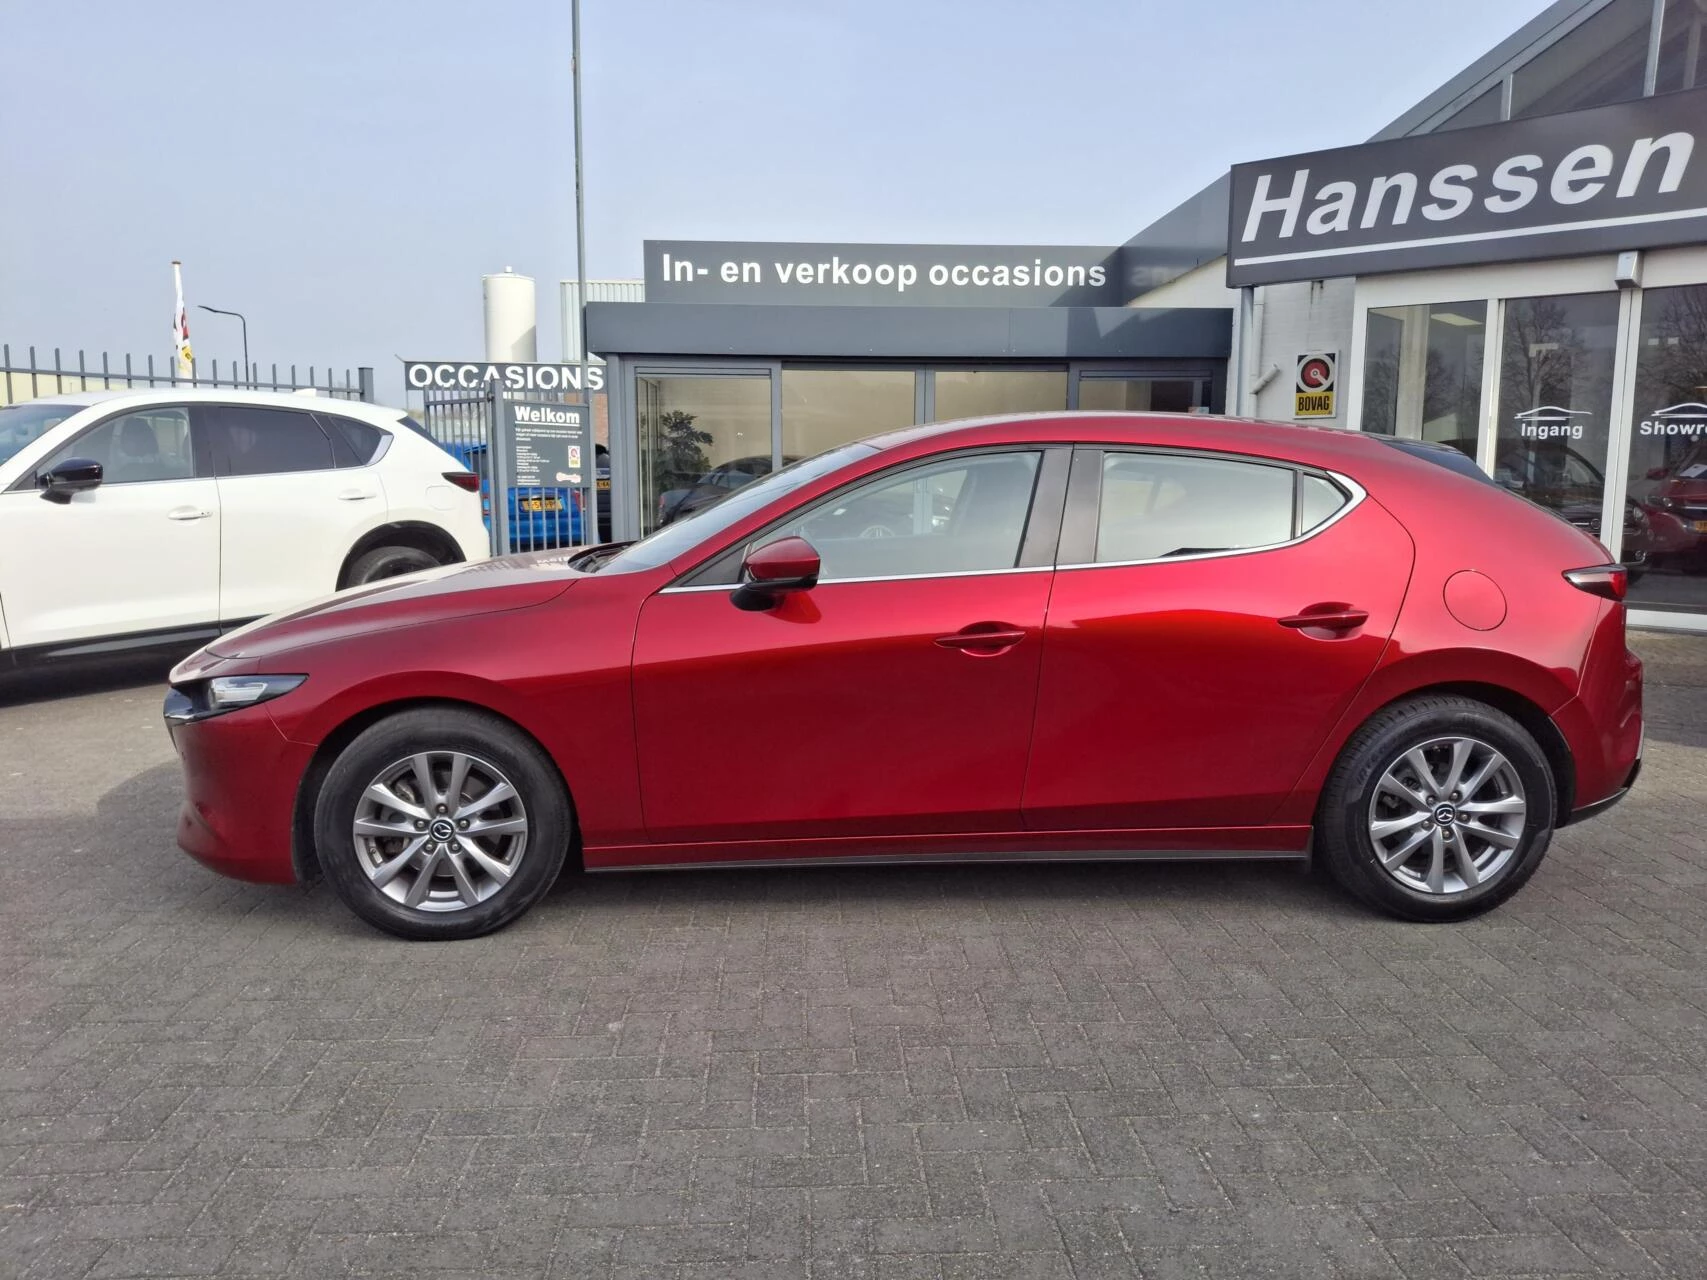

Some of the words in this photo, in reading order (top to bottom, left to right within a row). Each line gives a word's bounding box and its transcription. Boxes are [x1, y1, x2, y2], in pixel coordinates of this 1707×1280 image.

[1241, 132, 1695, 243] Hanssen
[662, 254, 709, 282] In-
[720, 260, 761, 283] en
[774, 256, 918, 292] verkoop
[928, 258, 1107, 288] occasions
[409, 364, 604, 390] OCCASIONS
[1298, 395, 1330, 412] BOVAG
[514, 405, 580, 423] Welkom
[1521, 423, 1583, 440] Ingang
[1640, 420, 1707, 436] Showr
